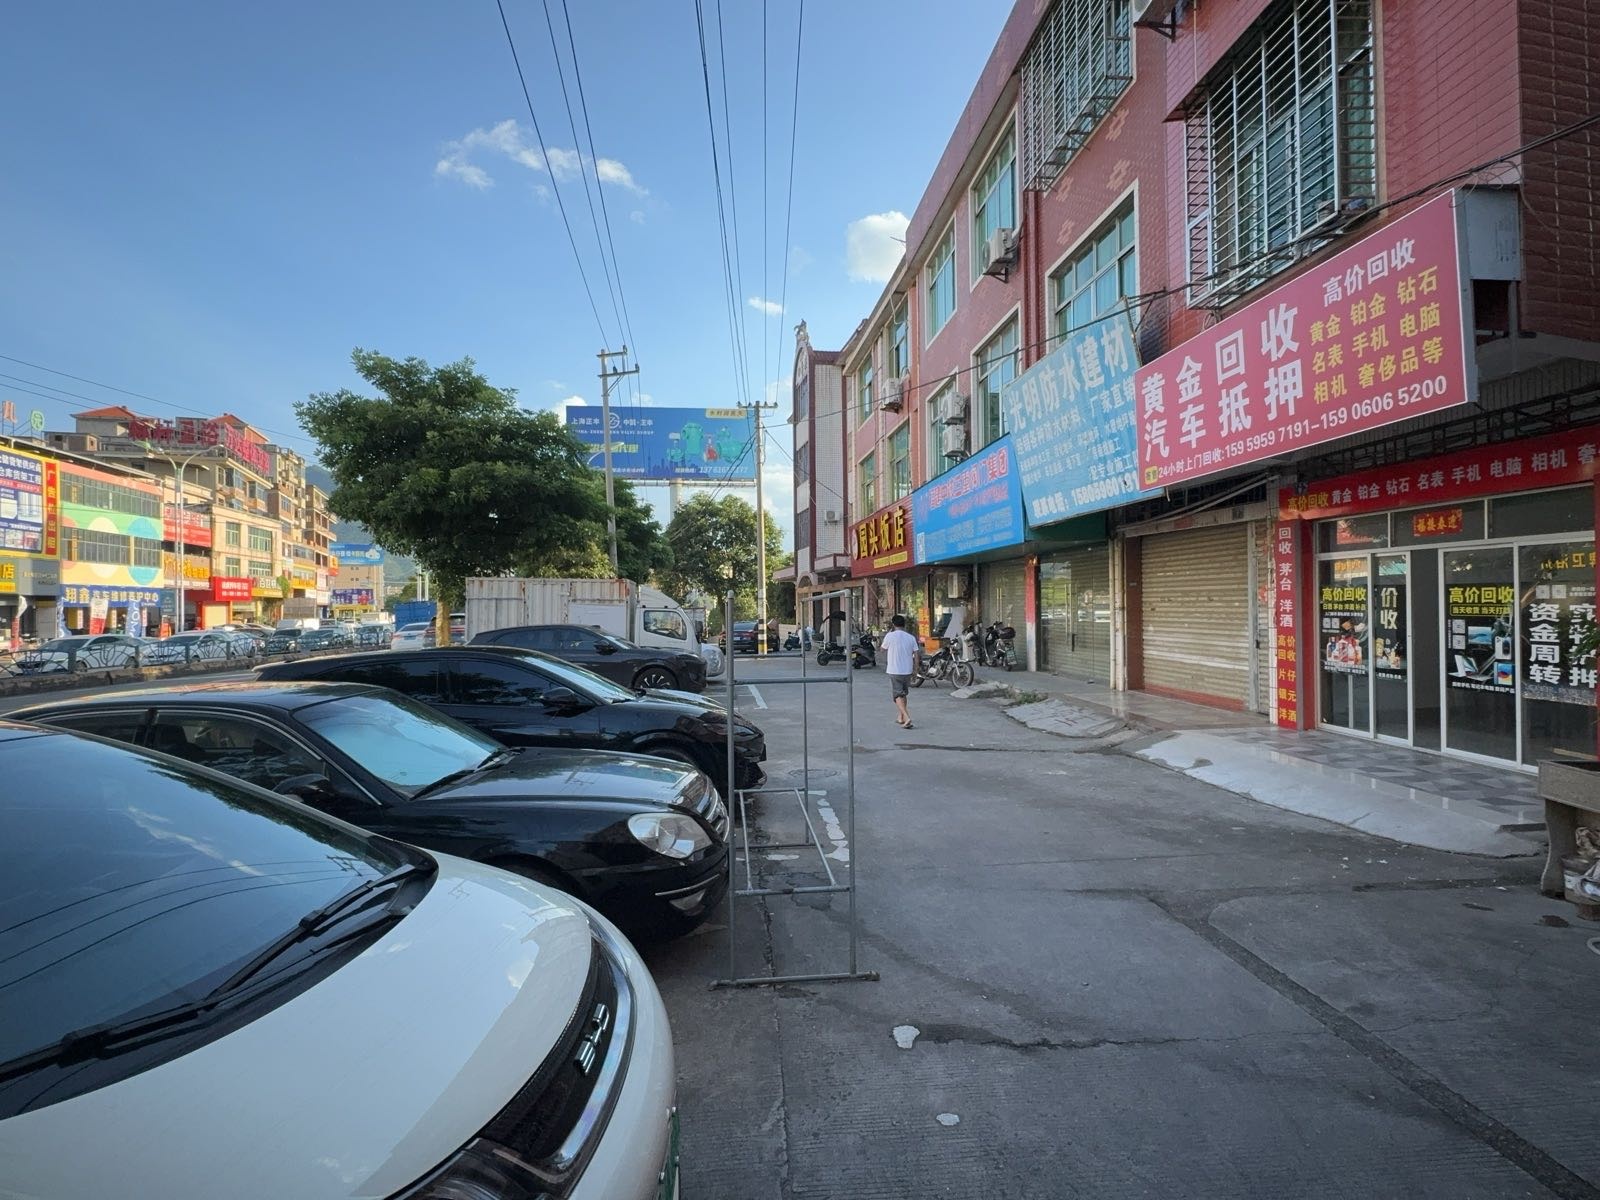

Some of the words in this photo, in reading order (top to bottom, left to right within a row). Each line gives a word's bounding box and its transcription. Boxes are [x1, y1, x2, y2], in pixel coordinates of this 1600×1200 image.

[1323, 237, 1416, 307] 高价回收
[1309, 313, 1341, 346] 黄金
[1350, 292, 1387, 326] 铂金
[1397, 265, 1438, 305] 钻石
[1312, 346, 1343, 375] 名表
[1352, 325, 1389, 359] 手机
[1400, 302, 1441, 339] 电脑
[1142, 303, 1300, 419] 黄金回收
[1313, 373, 1348, 404] 相机
[1143, 359, 1304, 461] 汽车抵押
[1246, 429, 1276, 451] 5959
[1351, 391, 1394, 420] 0606
[1398, 374, 1448, 408] 5200
[1287, 493, 1329, 512] 高价回收
[1332, 487, 1352, 505] 黄金
[1357, 484, 1381, 500] 铂金
[1386, 477, 1410, 494] 钻石
[1418, 472, 1444, 490] 名表
[1451, 464, 1482, 485] 手机
[1490, 456, 1522, 478] 电脑
[1531, 448, 1568, 471] 相机
[1278, 527, 1293, 555] 回收
[1278, 562, 1293, 591] 茅台
[1322, 587, 1366, 602] 高价回收
[1449, 586, 1515, 603] 高价回收
[1279, 599, 1294, 628] 洋酒
[1277, 634, 1296, 648] 高价
[1277, 649, 1296, 661] 回收
[1529, 603, 1562, 686] 资金周转
[1278, 667, 1297, 682] 片仔
[1278, 707, 1297, 722] 洋酒
